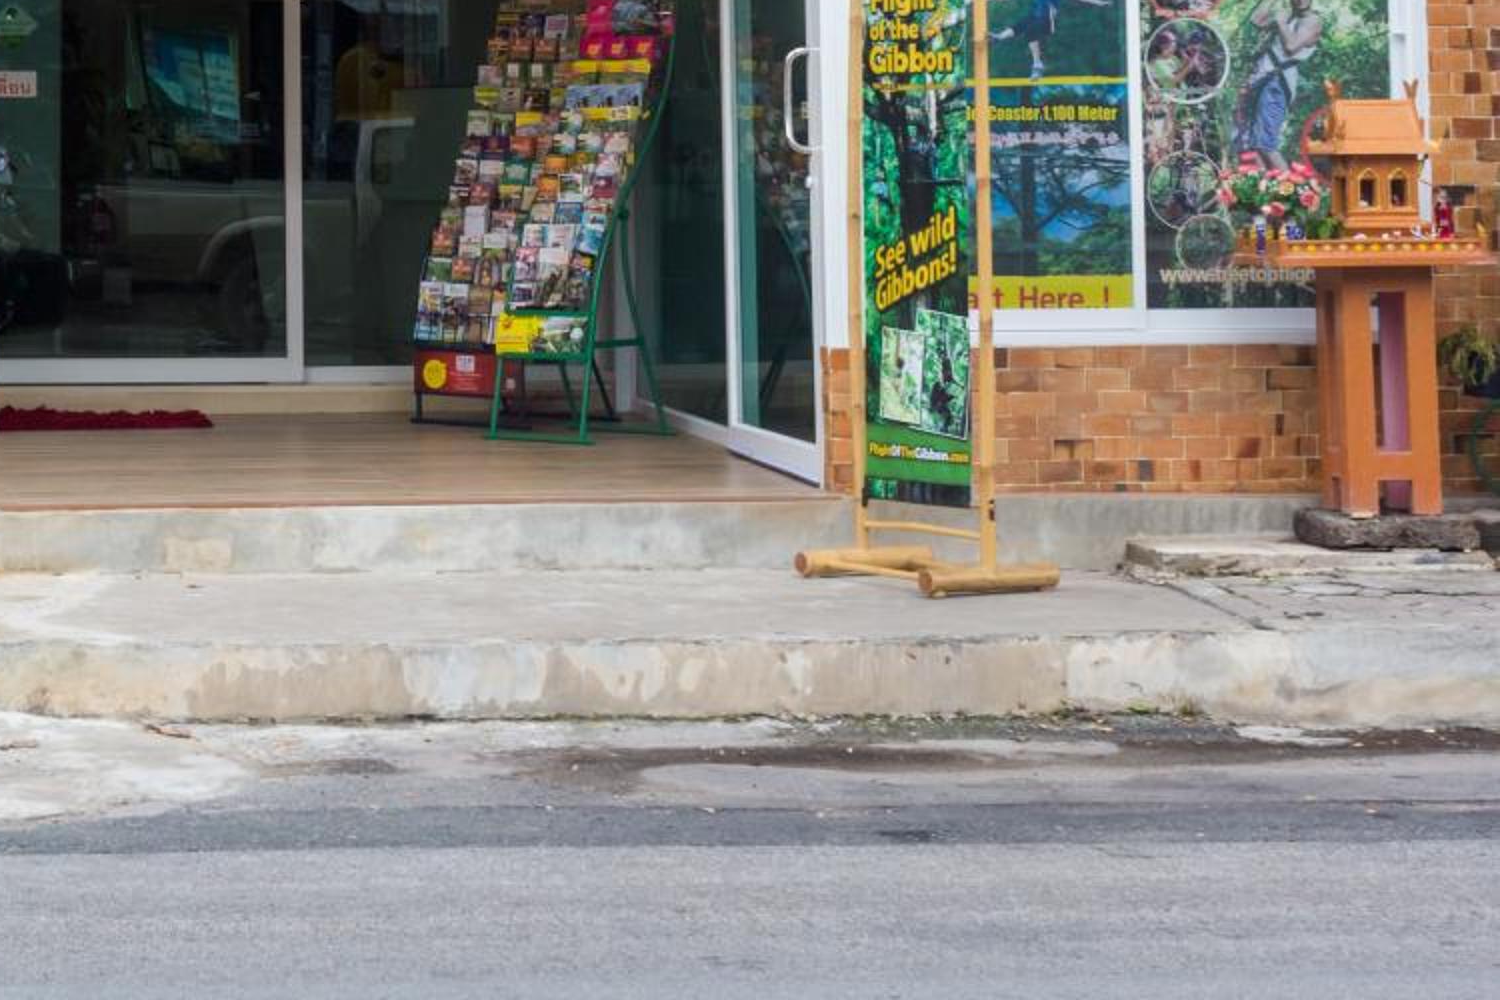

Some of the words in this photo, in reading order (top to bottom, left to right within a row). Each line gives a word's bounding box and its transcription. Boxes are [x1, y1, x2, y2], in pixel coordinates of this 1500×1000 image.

[869, 22, 885, 40] of
[889, 19, 918, 40] the
[869, 43, 954, 74] Gibbon
[875, 241, 906, 278] See
[910, 206, 956, 258] wild
[875, 242, 957, 312] Gibbons!
[1019, 286, 1085, 309] Here
